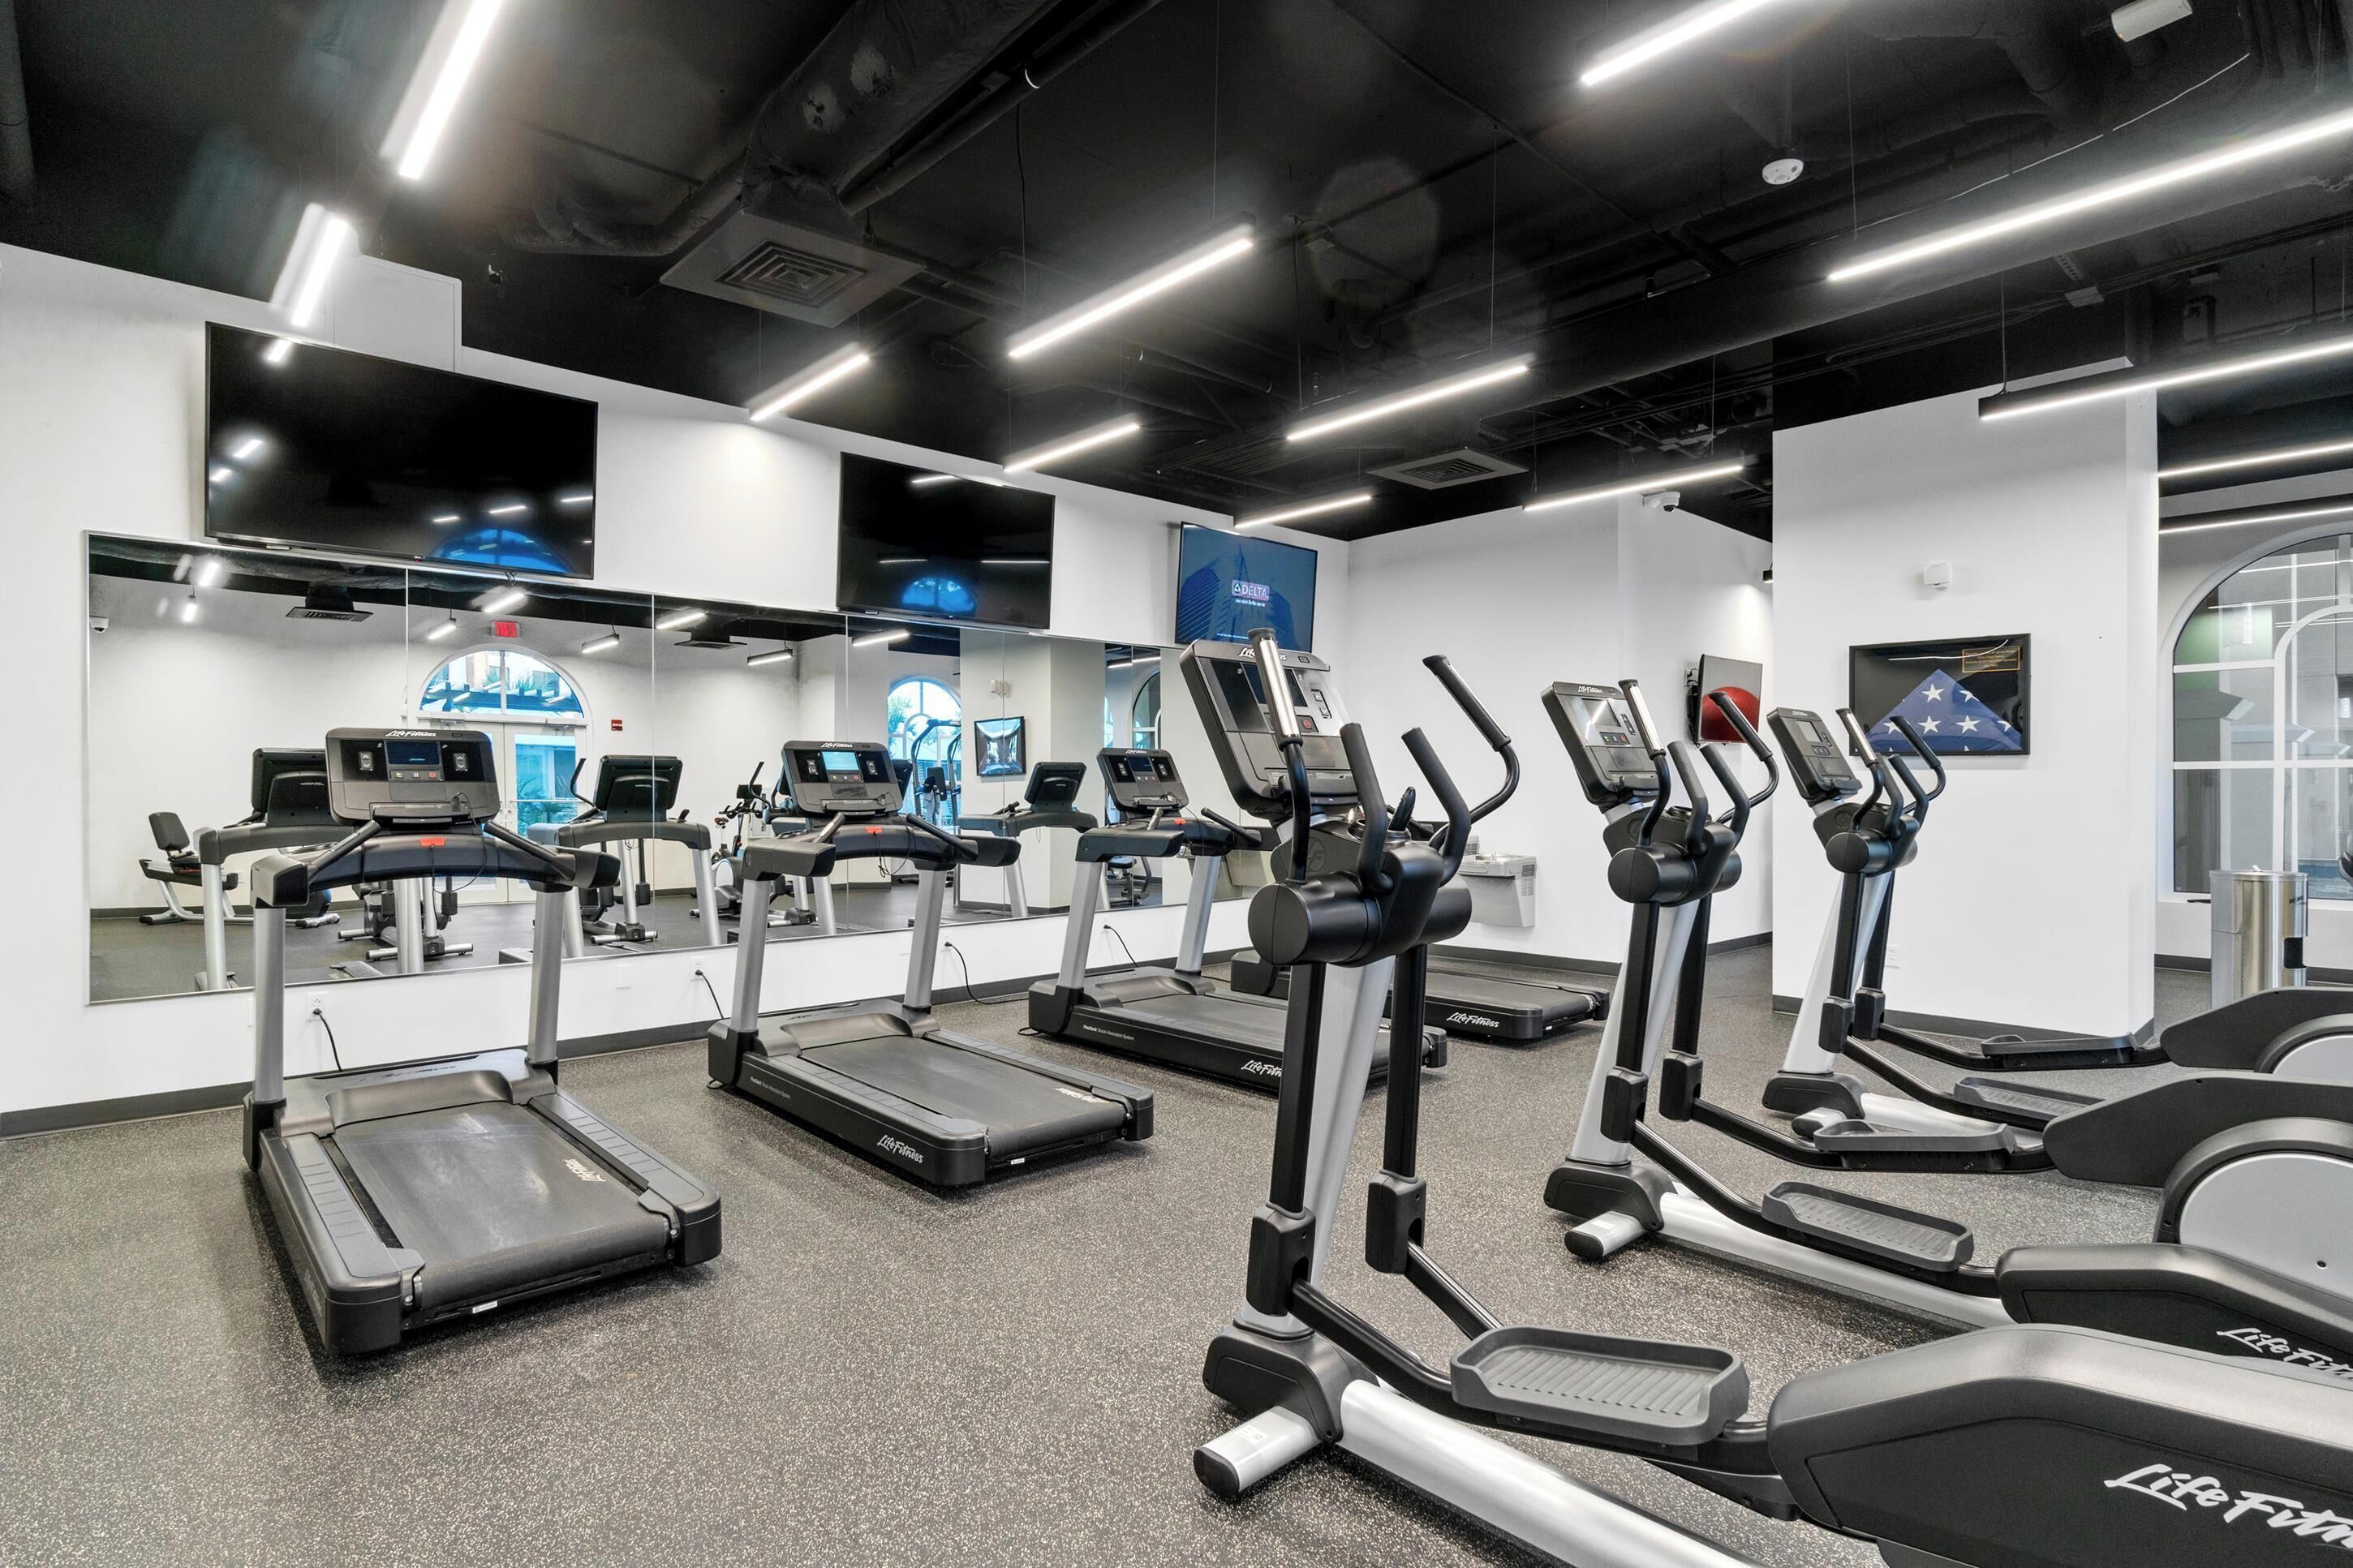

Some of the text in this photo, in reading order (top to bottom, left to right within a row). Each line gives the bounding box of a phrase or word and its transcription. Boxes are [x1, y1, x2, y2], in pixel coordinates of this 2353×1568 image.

[1241, 584, 1267, 599] DELTA
[1446, 1012, 1500, 1028] Life Fitness
[1241, 1059, 1283, 1078] Life Fitn
[876, 1134, 924, 1164] Life Fitness
[2216, 1327, 2291, 1354] Life
[2103, 1463, 2353, 1549] Life Fitn
